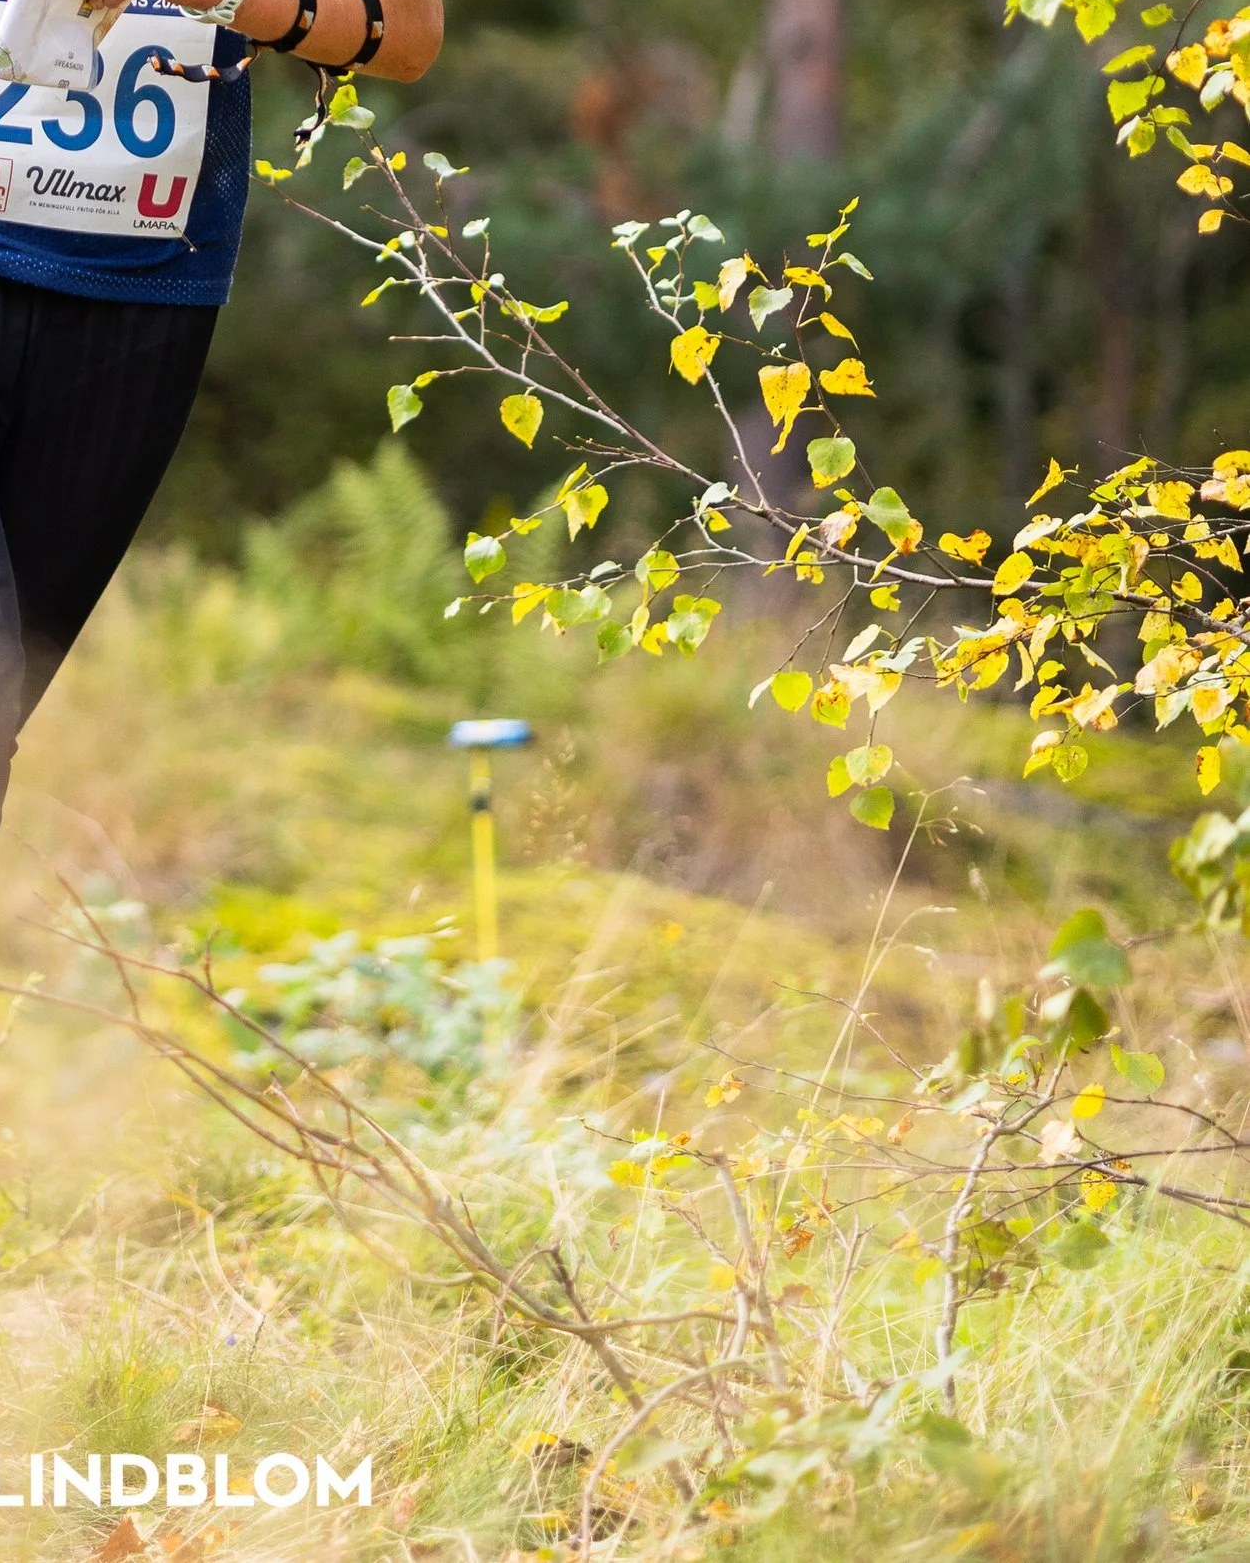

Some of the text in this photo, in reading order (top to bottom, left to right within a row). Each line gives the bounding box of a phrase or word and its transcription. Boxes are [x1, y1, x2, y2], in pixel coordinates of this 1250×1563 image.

[26, 166, 126, 203] Ullmax
[38, 202, 75, 212] MENINGSFULL
[76, 206, 95, 214] FRITID
[133, 219, 176, 231] UMARA
